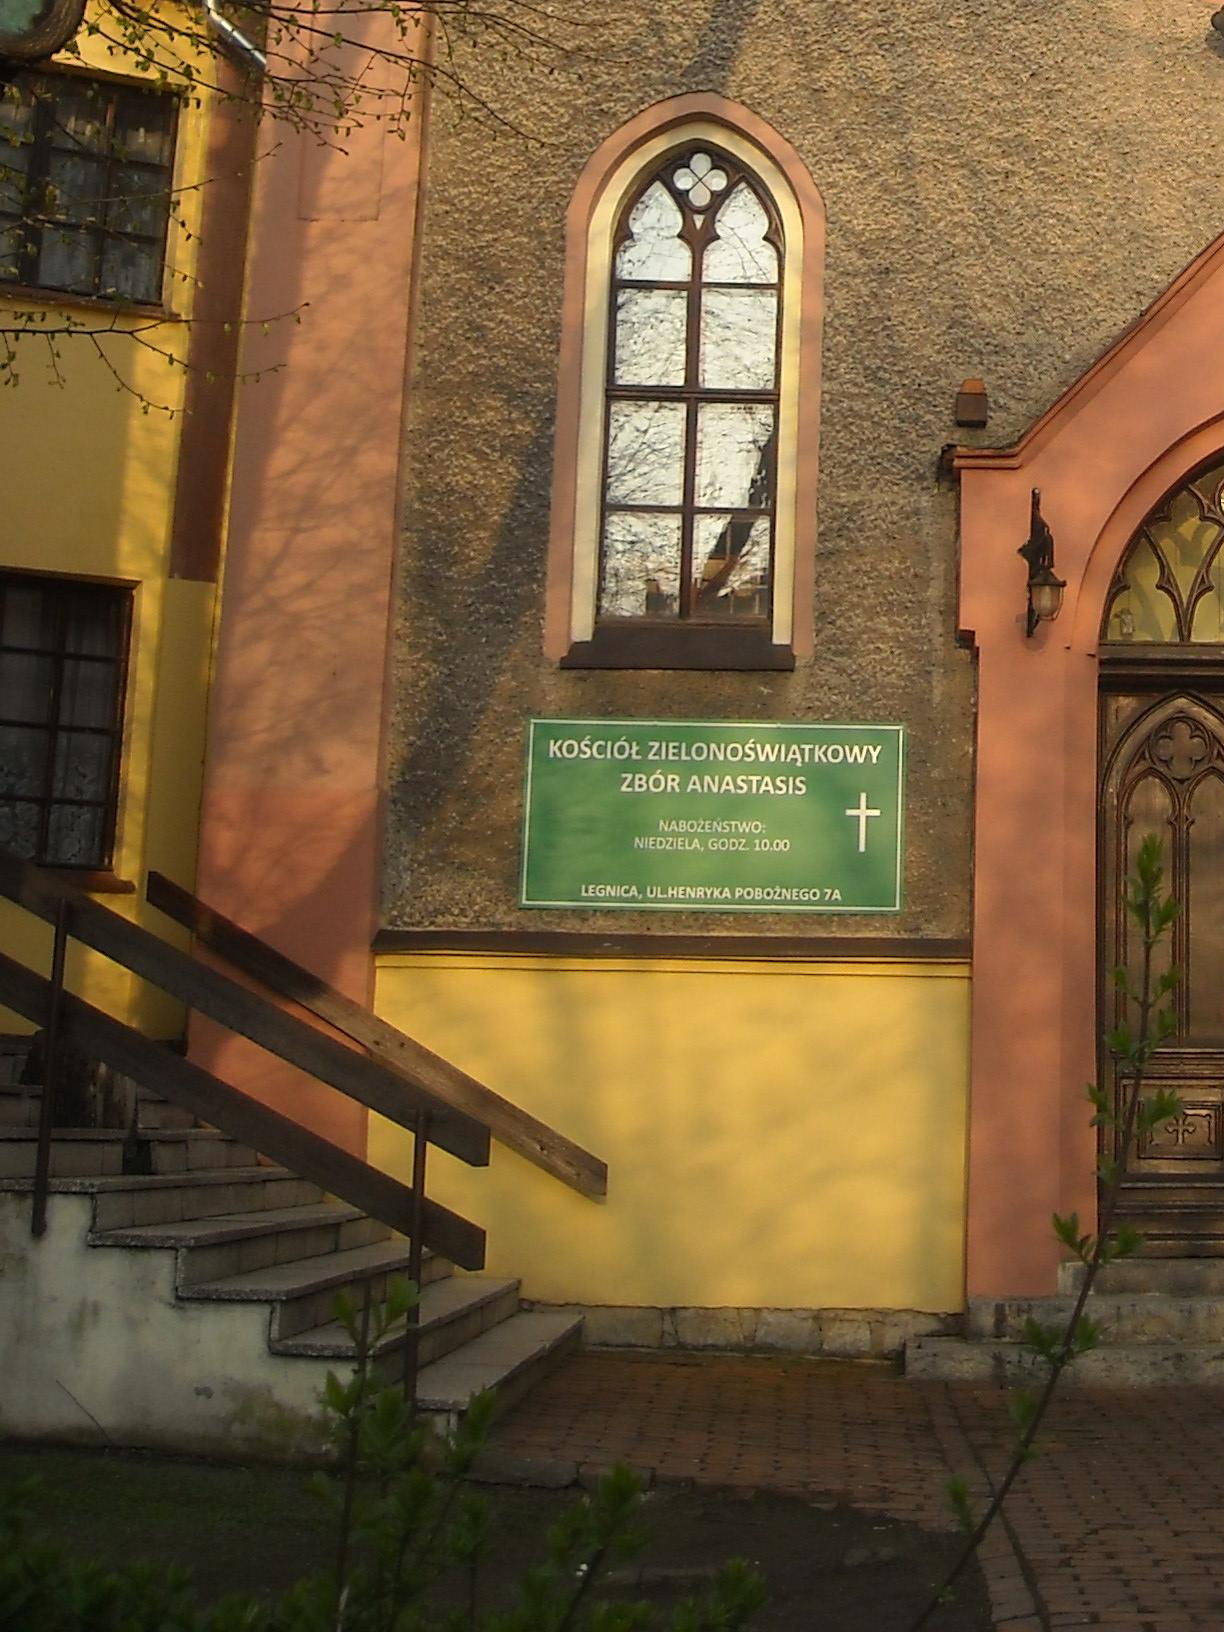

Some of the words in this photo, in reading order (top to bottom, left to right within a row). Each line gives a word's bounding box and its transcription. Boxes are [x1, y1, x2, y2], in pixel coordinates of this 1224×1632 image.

[548, 736, 642, 761] KOŚCIÓŁ
[648, 738, 882, 766] ZIELONOŚWIĄTKOWY
[620, 769, 680, 792] ZBÓR
[687, 774, 807, 795] ANASTASIS
[658, 818, 767, 834] NABOŻEŃSTWO:
[633, 836, 704, 852] NIEDZIELA,
[708, 839, 750, 851] GODZ.
[754, 839, 790, 852] 10.00
[581, 884, 642, 899] LEGNICA,
[735, 885, 819, 901] POBOŻNEGO
[823, 888, 841, 901] 7A
